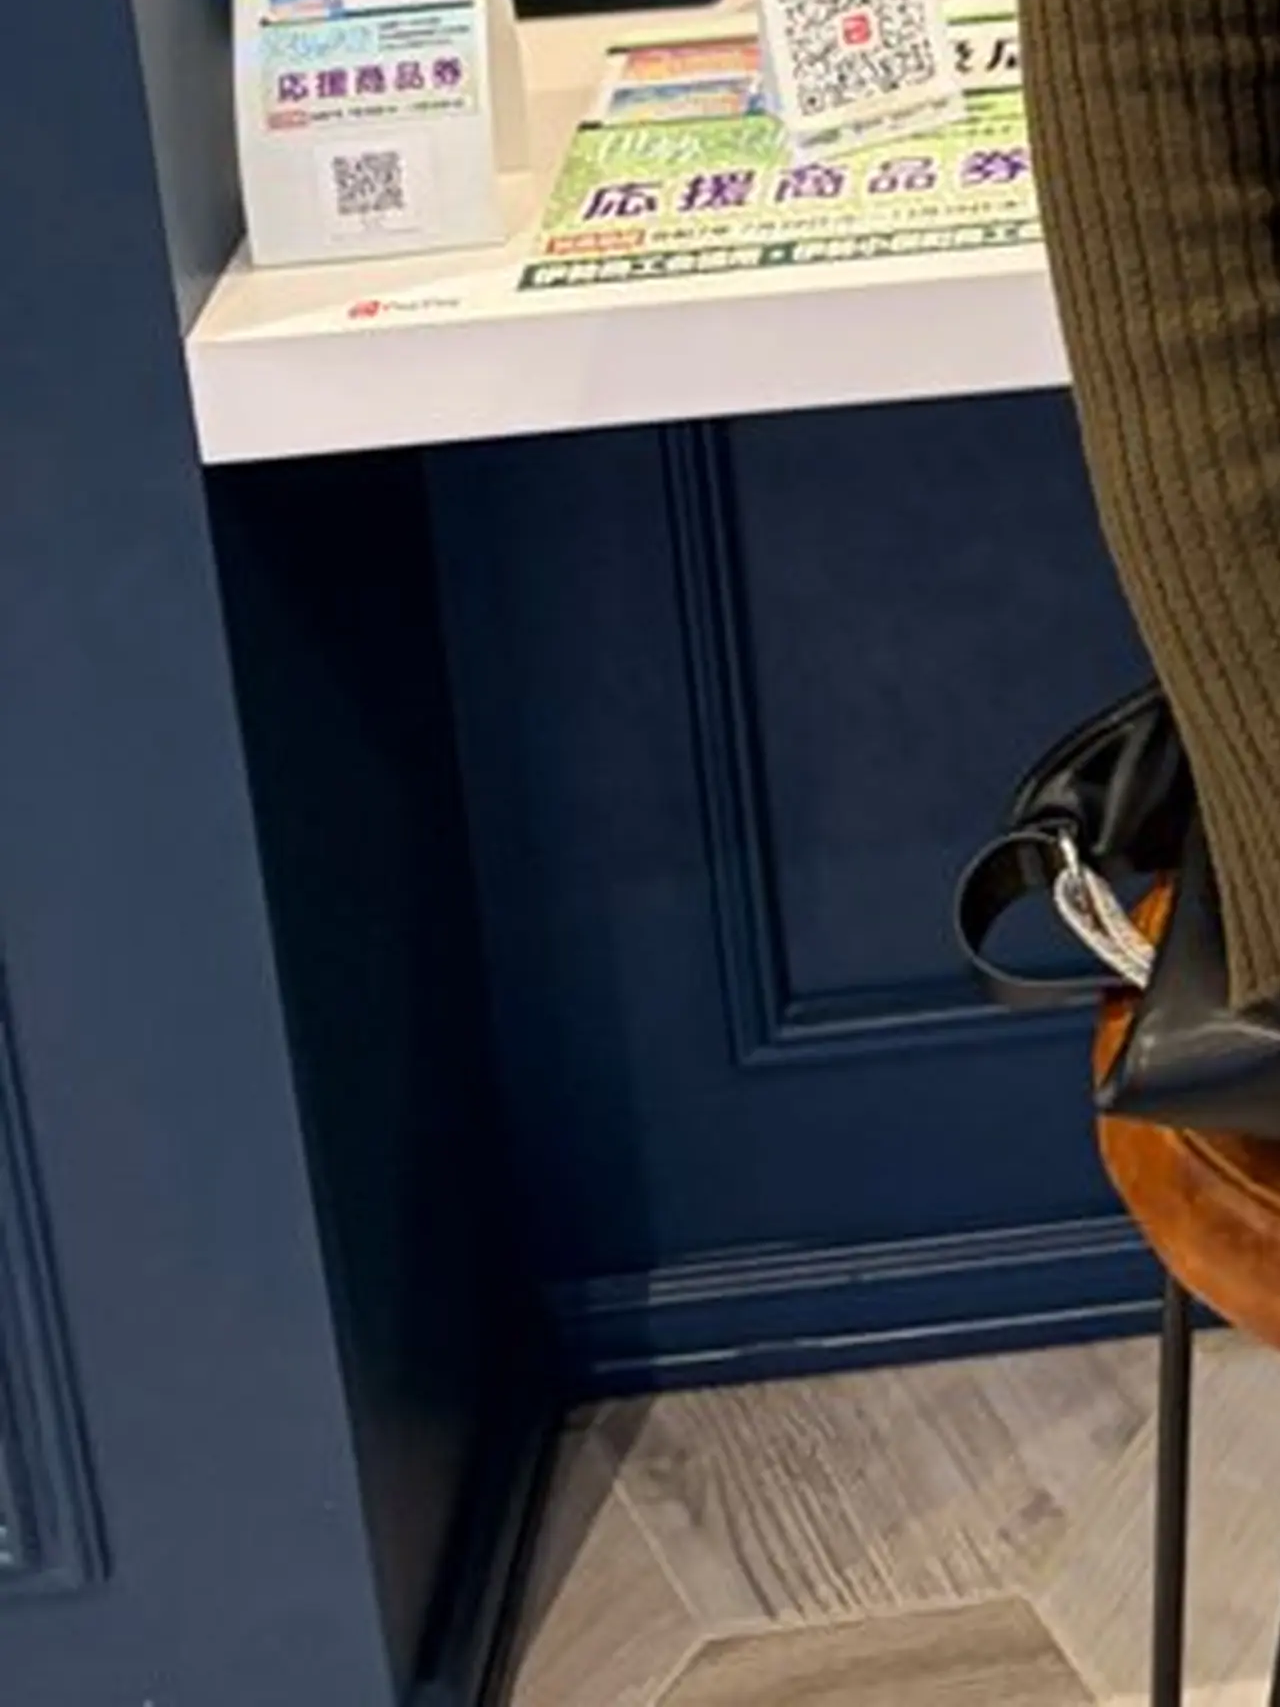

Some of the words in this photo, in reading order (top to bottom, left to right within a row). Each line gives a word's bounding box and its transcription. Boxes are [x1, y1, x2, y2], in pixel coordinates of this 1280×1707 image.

[277, 56, 462, 103] 応援商品券
[583, 149, 1028, 221] 応援商品券
